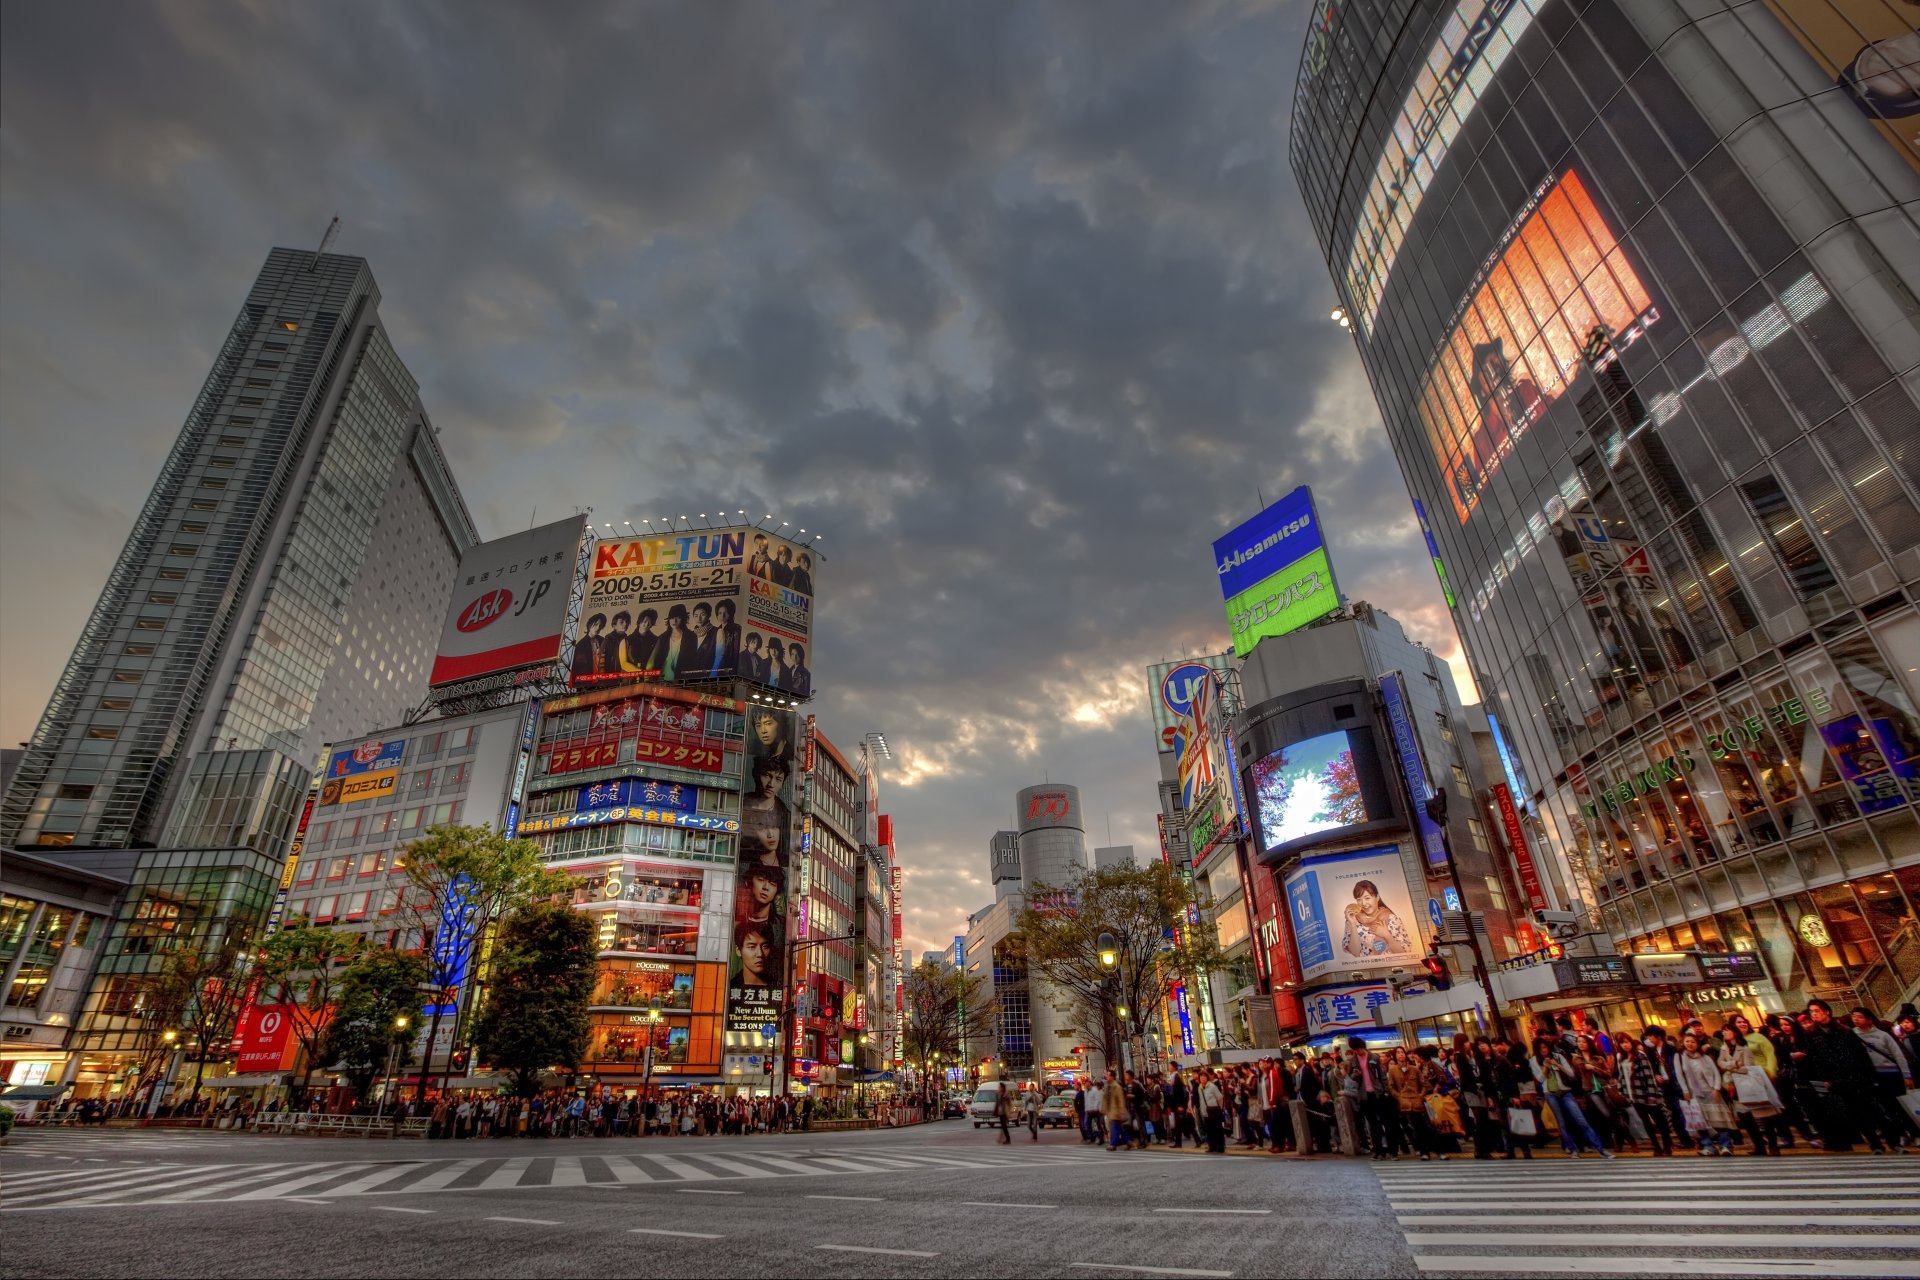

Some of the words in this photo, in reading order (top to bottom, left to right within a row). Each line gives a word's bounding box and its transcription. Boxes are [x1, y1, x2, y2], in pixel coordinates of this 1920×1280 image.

[596, 532, 745, 569] KAT-TUN
[1217, 513, 1310, 574] Hisamitsu
[591, 571, 692, 596] 2009.5.15
[749, 594, 790, 615] 2009.5.15
[750, 577, 809, 612] KAT-TUN
[1232, 571, 1324, 634] サロンパス
[429, 671, 516, 700] transcosmos
[515, 666, 551, 684] group
[552, 743, 616, 769] プライス
[637, 741, 720, 766] コンタクト
[343, 779, 378, 796] プロミス
[381, 778, 392, 788] 4F
[518, 809, 610, 833] 英会話&留学イーオン
[611, 809, 623, 818] 6F
[628, 807, 723, 829] 英会話イーオン
[726, 822, 738, 830] 6F
[1027, 799, 1070, 823] 109
[1007, 834, 1020, 849] TH
[1001, 848, 1020, 864] PRI
[645, 867, 669, 875] Natural
[1261, 918, 1280, 949] クスリ
[636, 962, 669, 970] L'OCCITANE
[1580, 971, 1611, 982] 渋谷駅
[730, 988, 783, 1001] 東方神起
[734, 1006, 751, 1014] New
[752, 1006, 776, 1014] Album
[733, 1022, 747, 1030] 3.25
[747, 1022, 758, 1030] ON
[240, 1051, 282, 1061] 三菱東京UFJ銀行
[1044, 1060, 1065, 1068] SPRING
